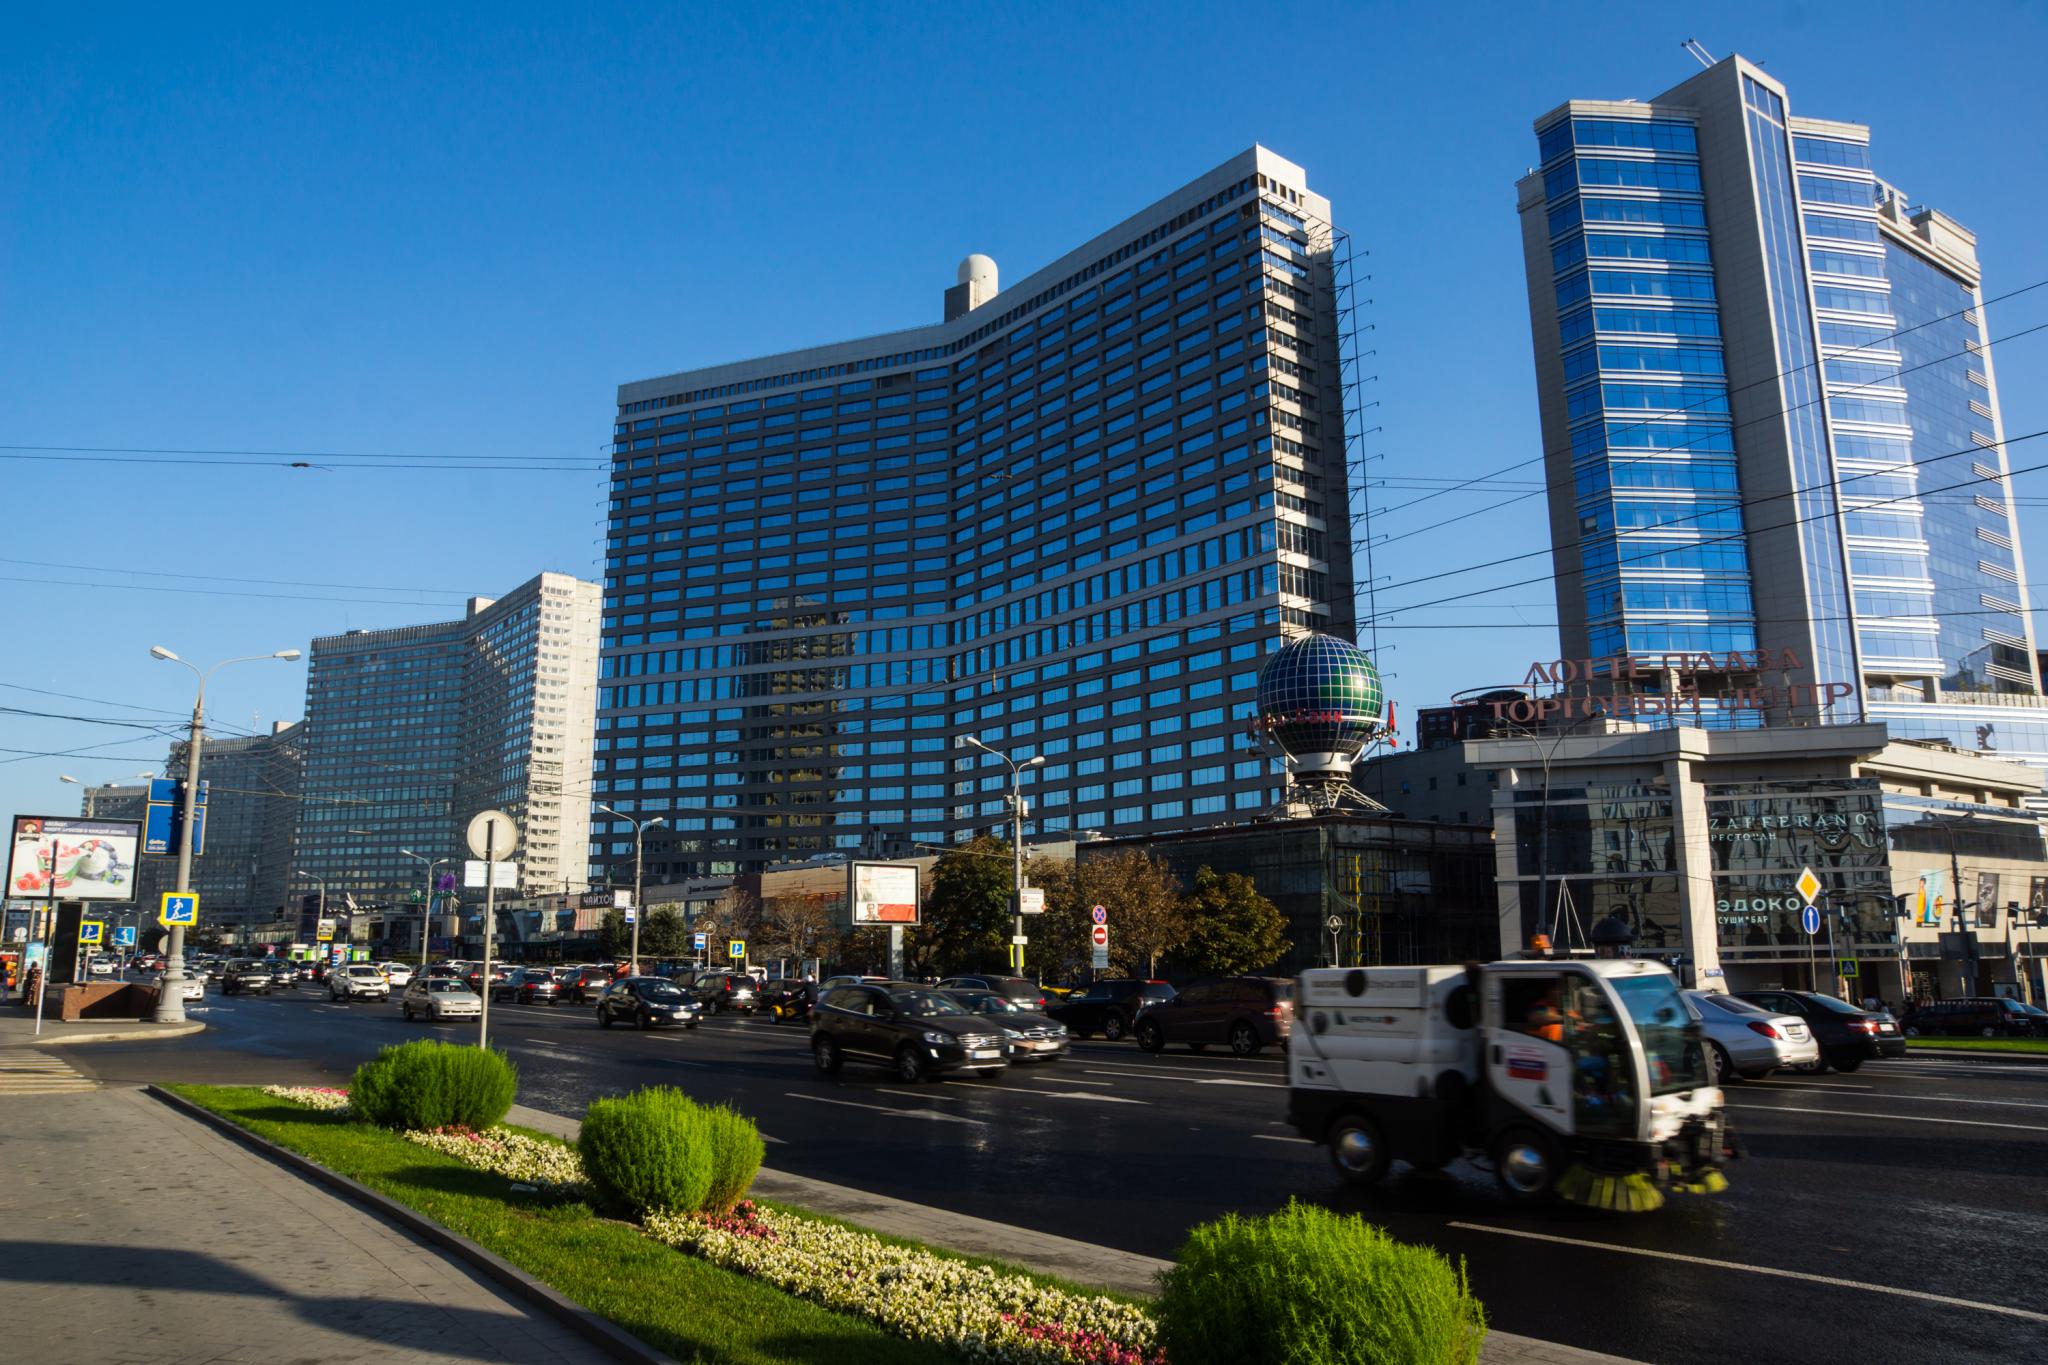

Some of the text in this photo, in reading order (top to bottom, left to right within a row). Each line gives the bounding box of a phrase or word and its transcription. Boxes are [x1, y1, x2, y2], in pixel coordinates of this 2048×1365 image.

[1523, 645, 1804, 685] ЛОТТЕ ПЛАЗА
[1486, 681, 1854, 723] ТОРГОВЫЙ ЦЕНТР
[1710, 813, 1868, 830] ZAFFERANO
[1717, 897, 1801, 912] ЭДОКО
